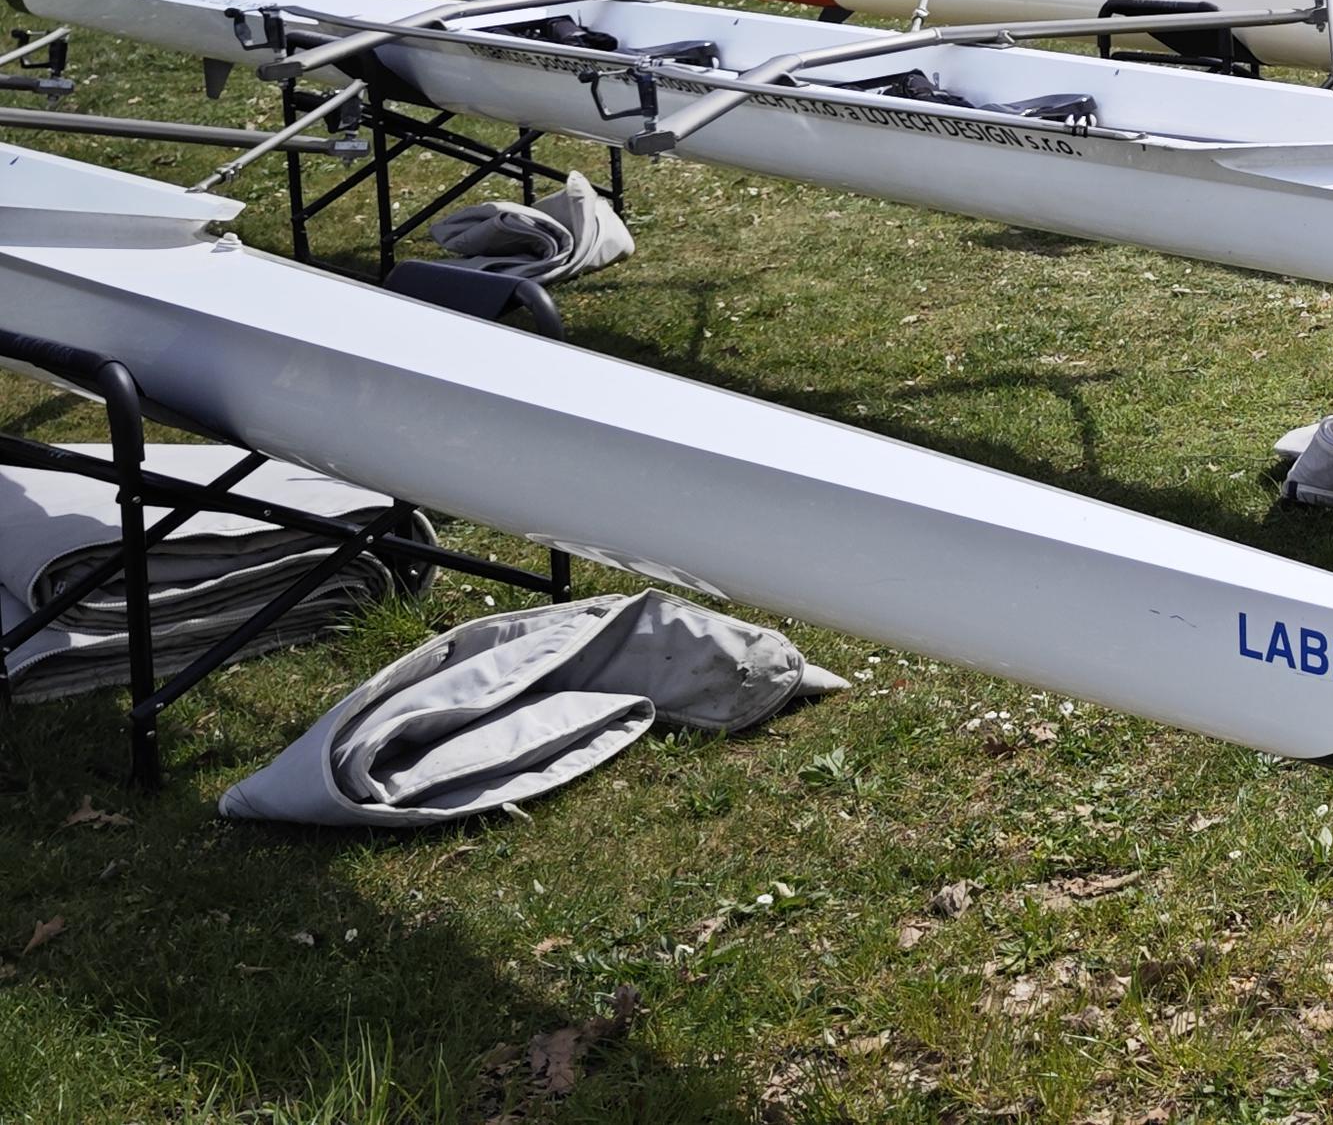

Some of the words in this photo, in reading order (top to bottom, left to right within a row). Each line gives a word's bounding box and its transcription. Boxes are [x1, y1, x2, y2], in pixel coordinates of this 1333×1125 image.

[860, 106, 941, 135] LOTECH
[943, 116, 1024, 148] DESIGN
[1029, 134, 1083, 156] s.r.o.
